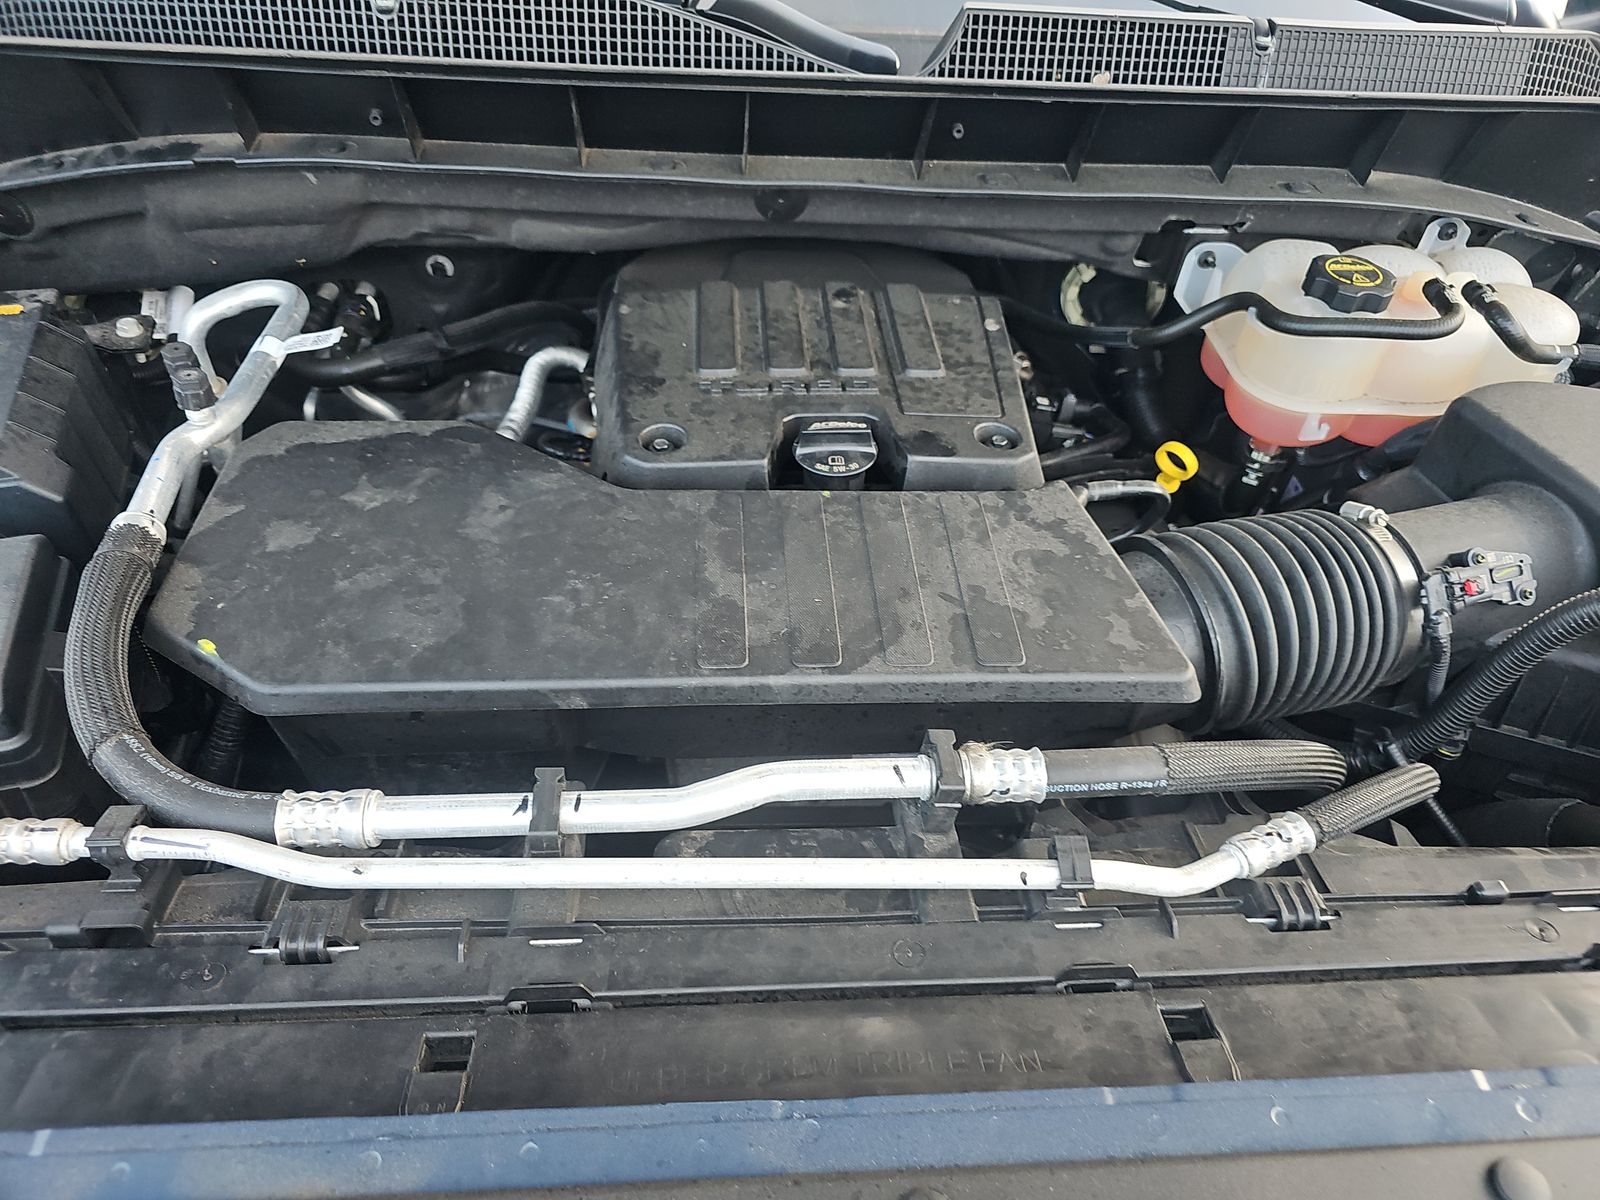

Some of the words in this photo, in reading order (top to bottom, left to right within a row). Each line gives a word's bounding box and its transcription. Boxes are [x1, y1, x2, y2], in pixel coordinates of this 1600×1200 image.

[814, 463, 831, 472] SAE
[832, 462, 860, 473] 5W-30
[1089, 782, 1120, 791] HOSE
[852, 1049, 970, 1077] TRIPLE
[977, 1048, 1044, 1074] FAN
